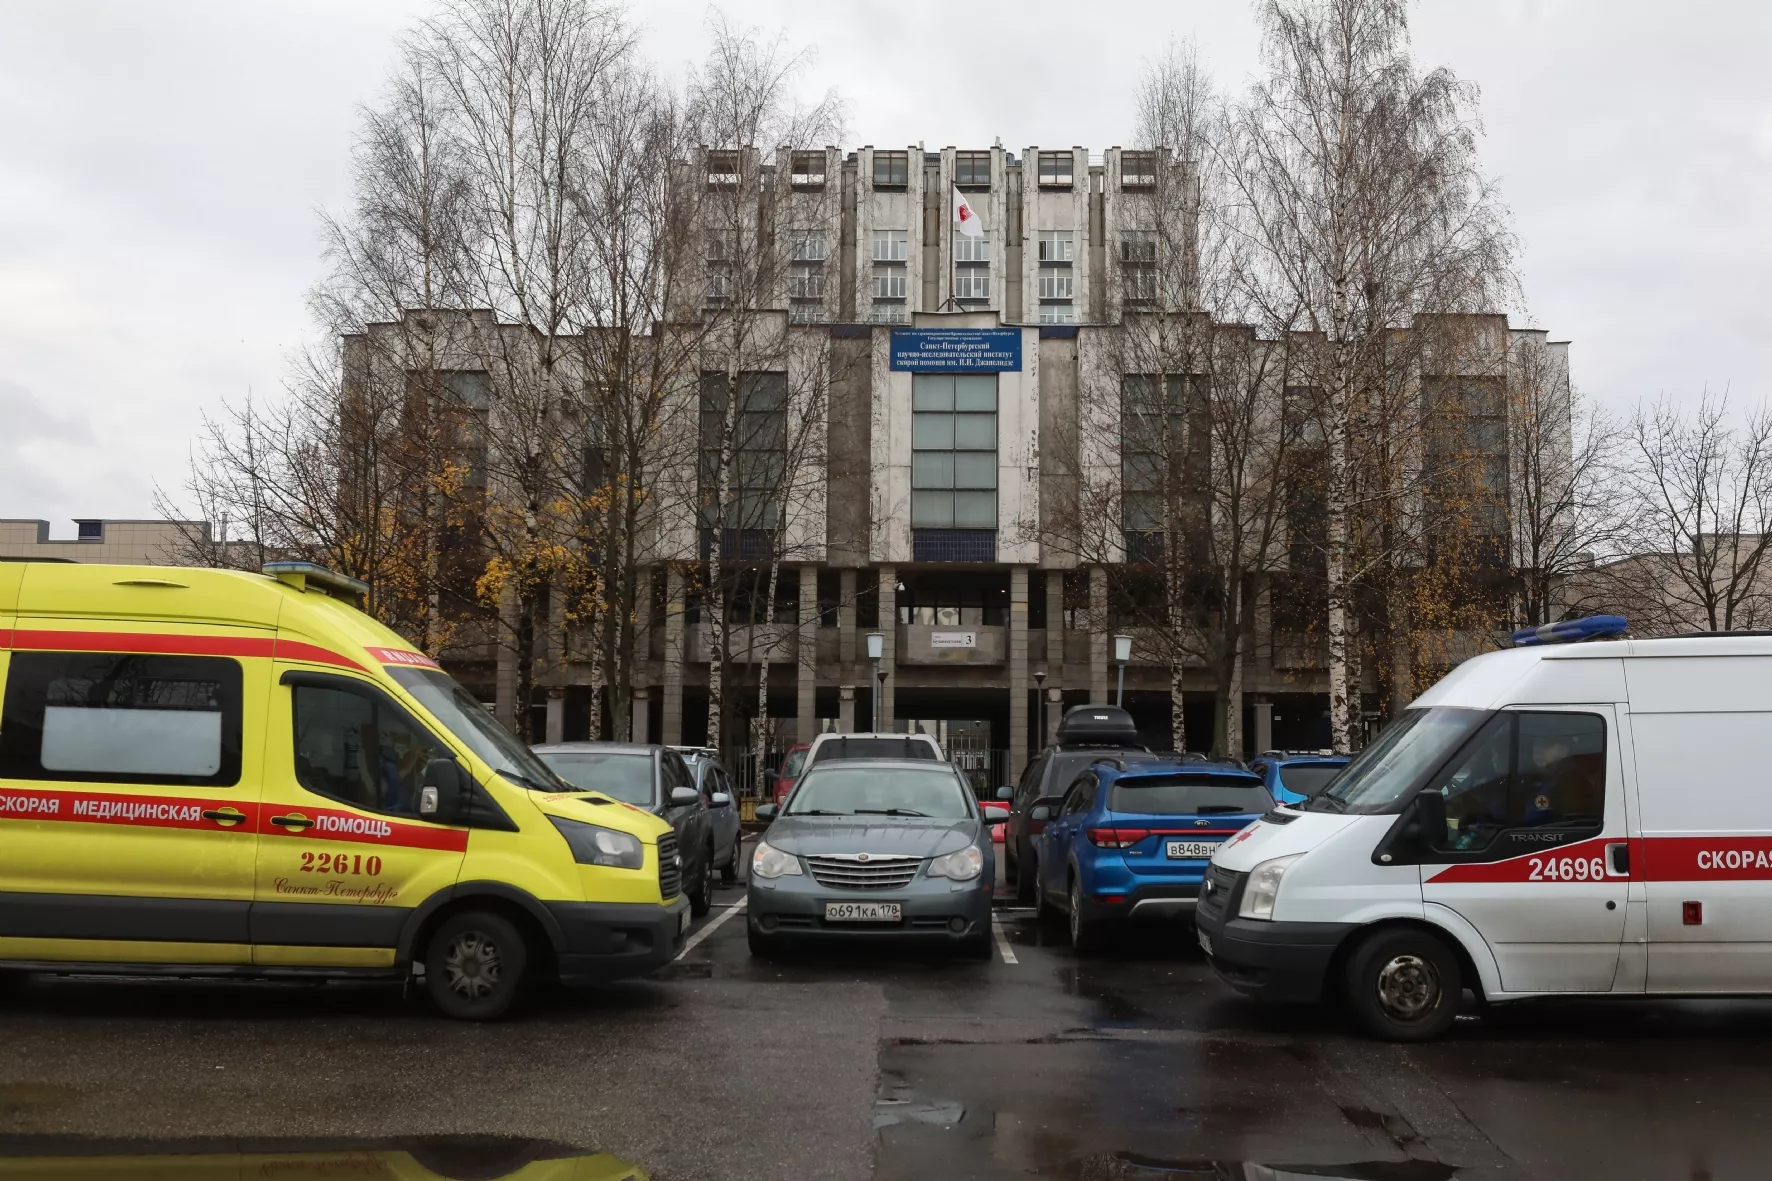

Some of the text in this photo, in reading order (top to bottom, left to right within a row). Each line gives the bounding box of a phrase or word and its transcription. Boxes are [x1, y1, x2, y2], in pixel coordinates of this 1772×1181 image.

[920, 342, 990, 351] Санкт-Петербургский
[897, 351, 1013, 360] научно-исследовательский институт
[896, 358, 919, 367] скорой
[959, 358, 974, 366] И.И.
[974, 358, 1014, 367] Джанелидзе
[965, 635, 972, 645] 3
[0, 795, 392, 838] СКОРАЯ МЕДИЦИНСКАЯ ПОМОЩЬ
[1510, 833, 1565, 842] TRANSIT
[1170, 843, 1216, 855] В848ВН
[300, 852, 382, 876] 22610
[1697, 850, 1772, 870] СКОРА
[1528, 857, 1605, 881] 24696
[273, 877, 398, 904] Санкт-Петербург
[880, 904, 898, 915] 178
